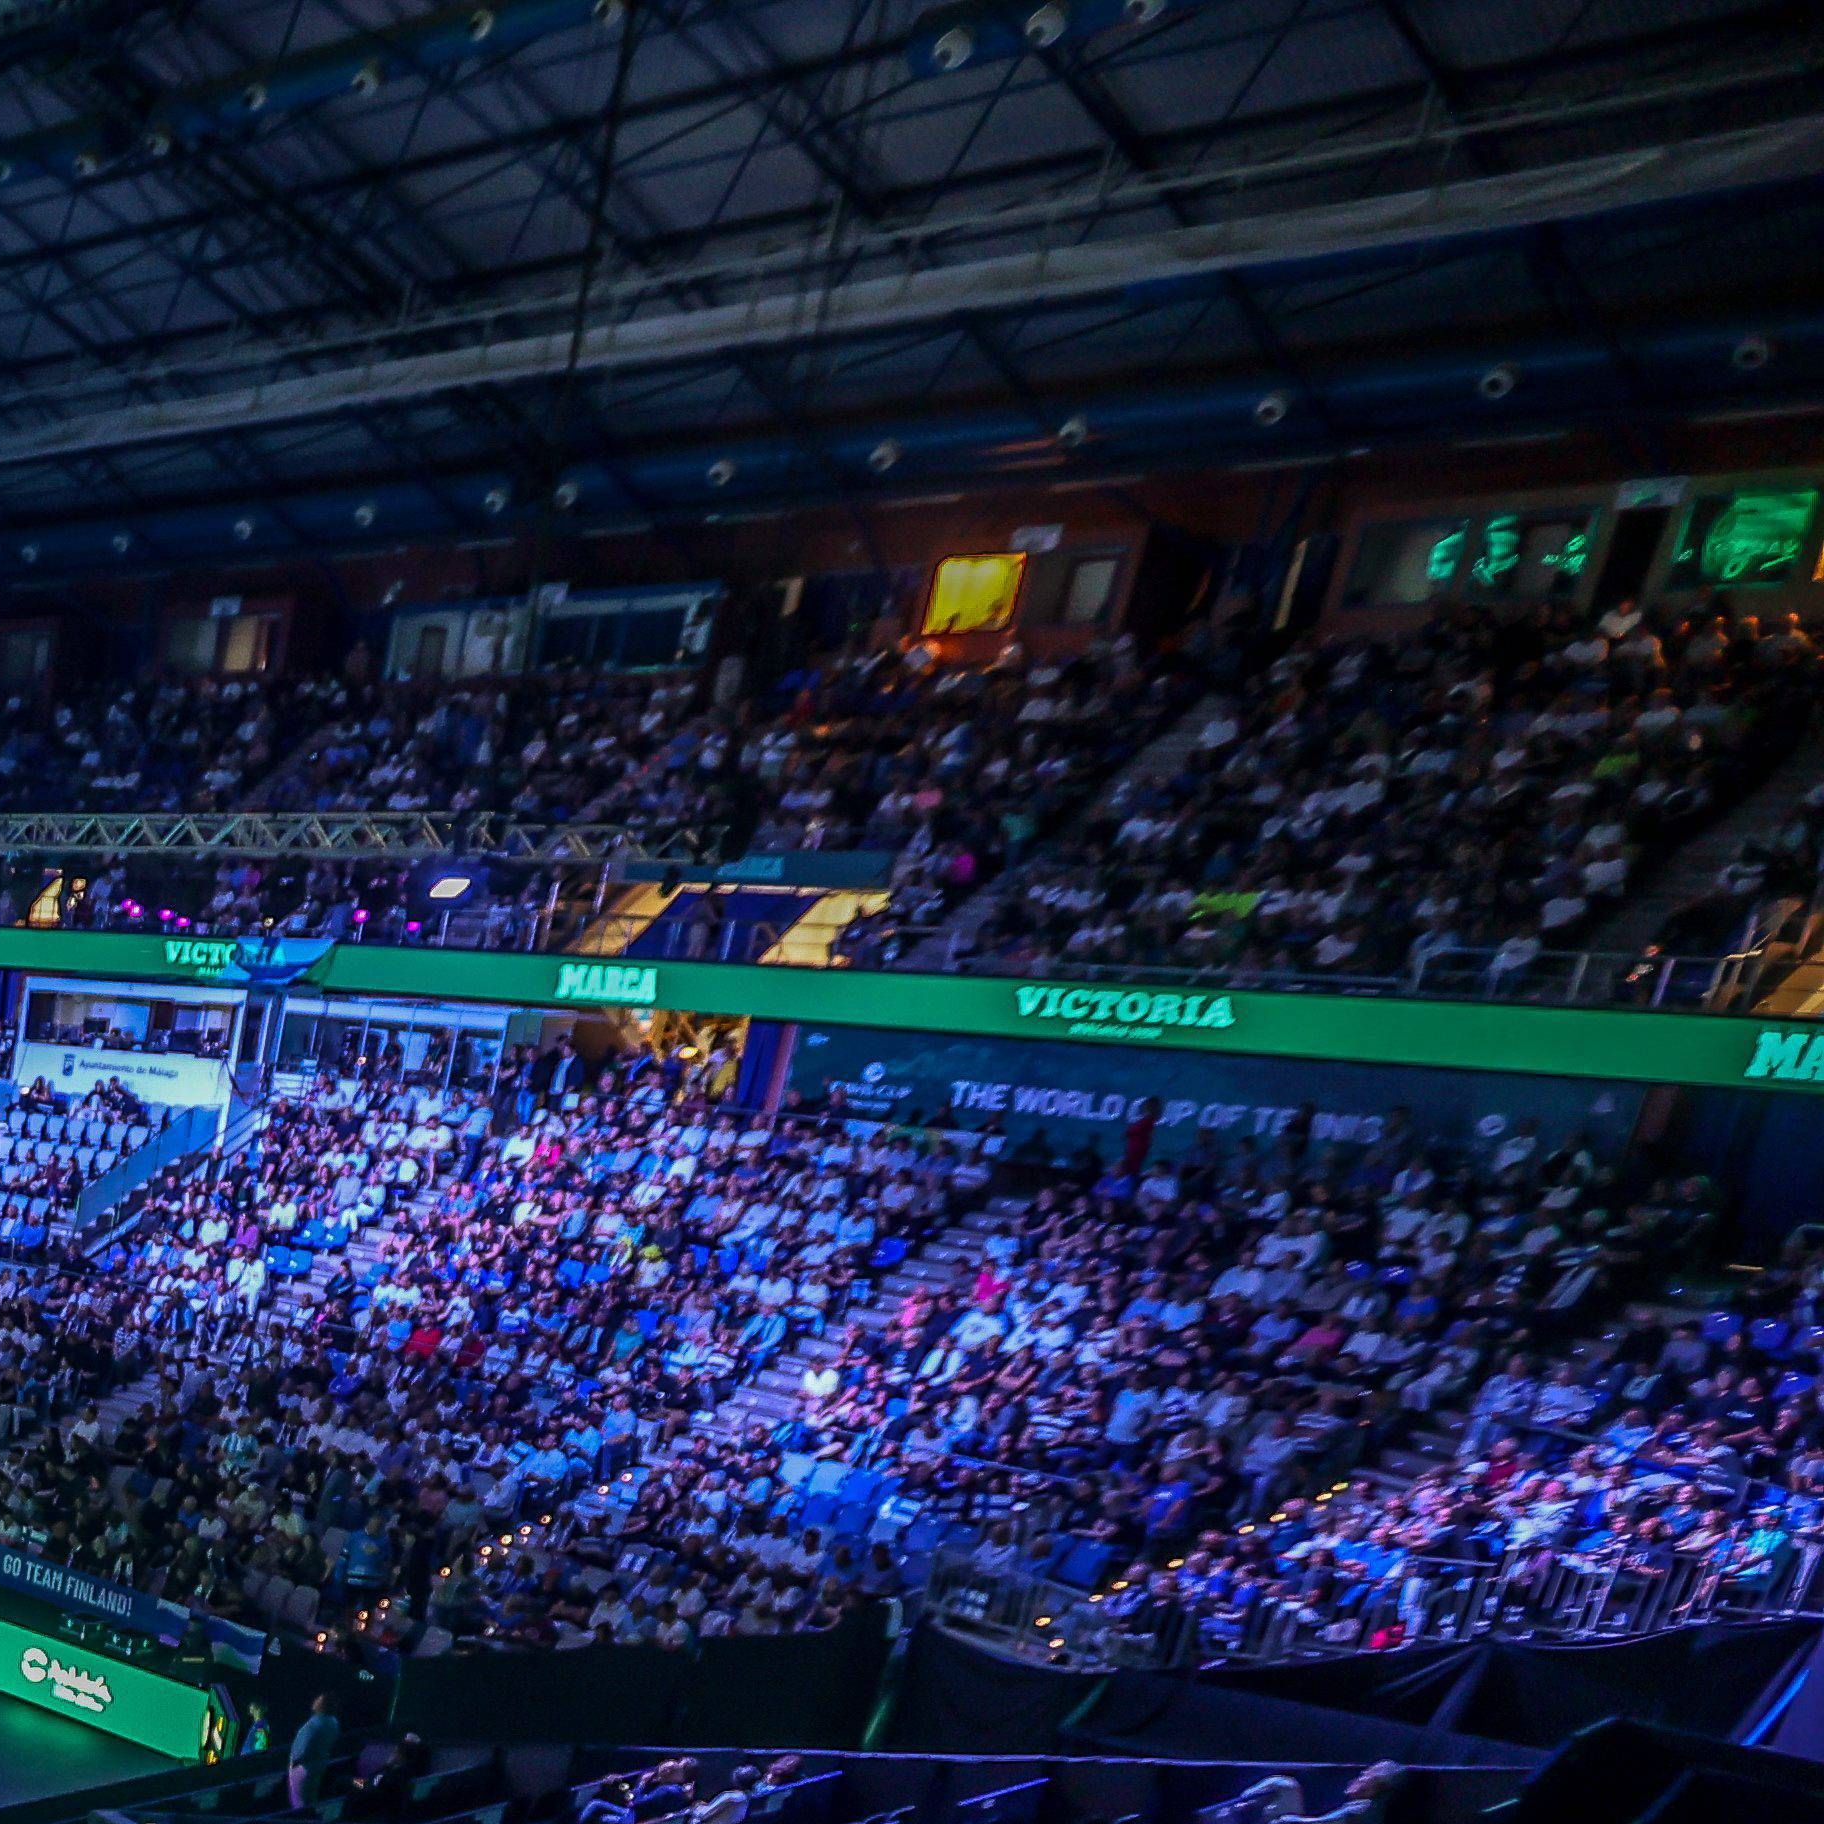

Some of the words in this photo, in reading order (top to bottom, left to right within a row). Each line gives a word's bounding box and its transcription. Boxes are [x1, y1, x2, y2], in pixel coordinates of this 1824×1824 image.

[555, 962, 657, 1004] MARCA
[1014, 985, 1237, 1028] VICTORIA
[951, 1079, 1012, 1112] THE
[1013, 1084, 1126, 1122] WORLD
[1196, 1104, 1249, 1131] OF
[2, 1553, 22, 1578] GO
[25, 1559, 64, 1593] TEAM
[64, 1575, 133, 1618] FINLAND!
